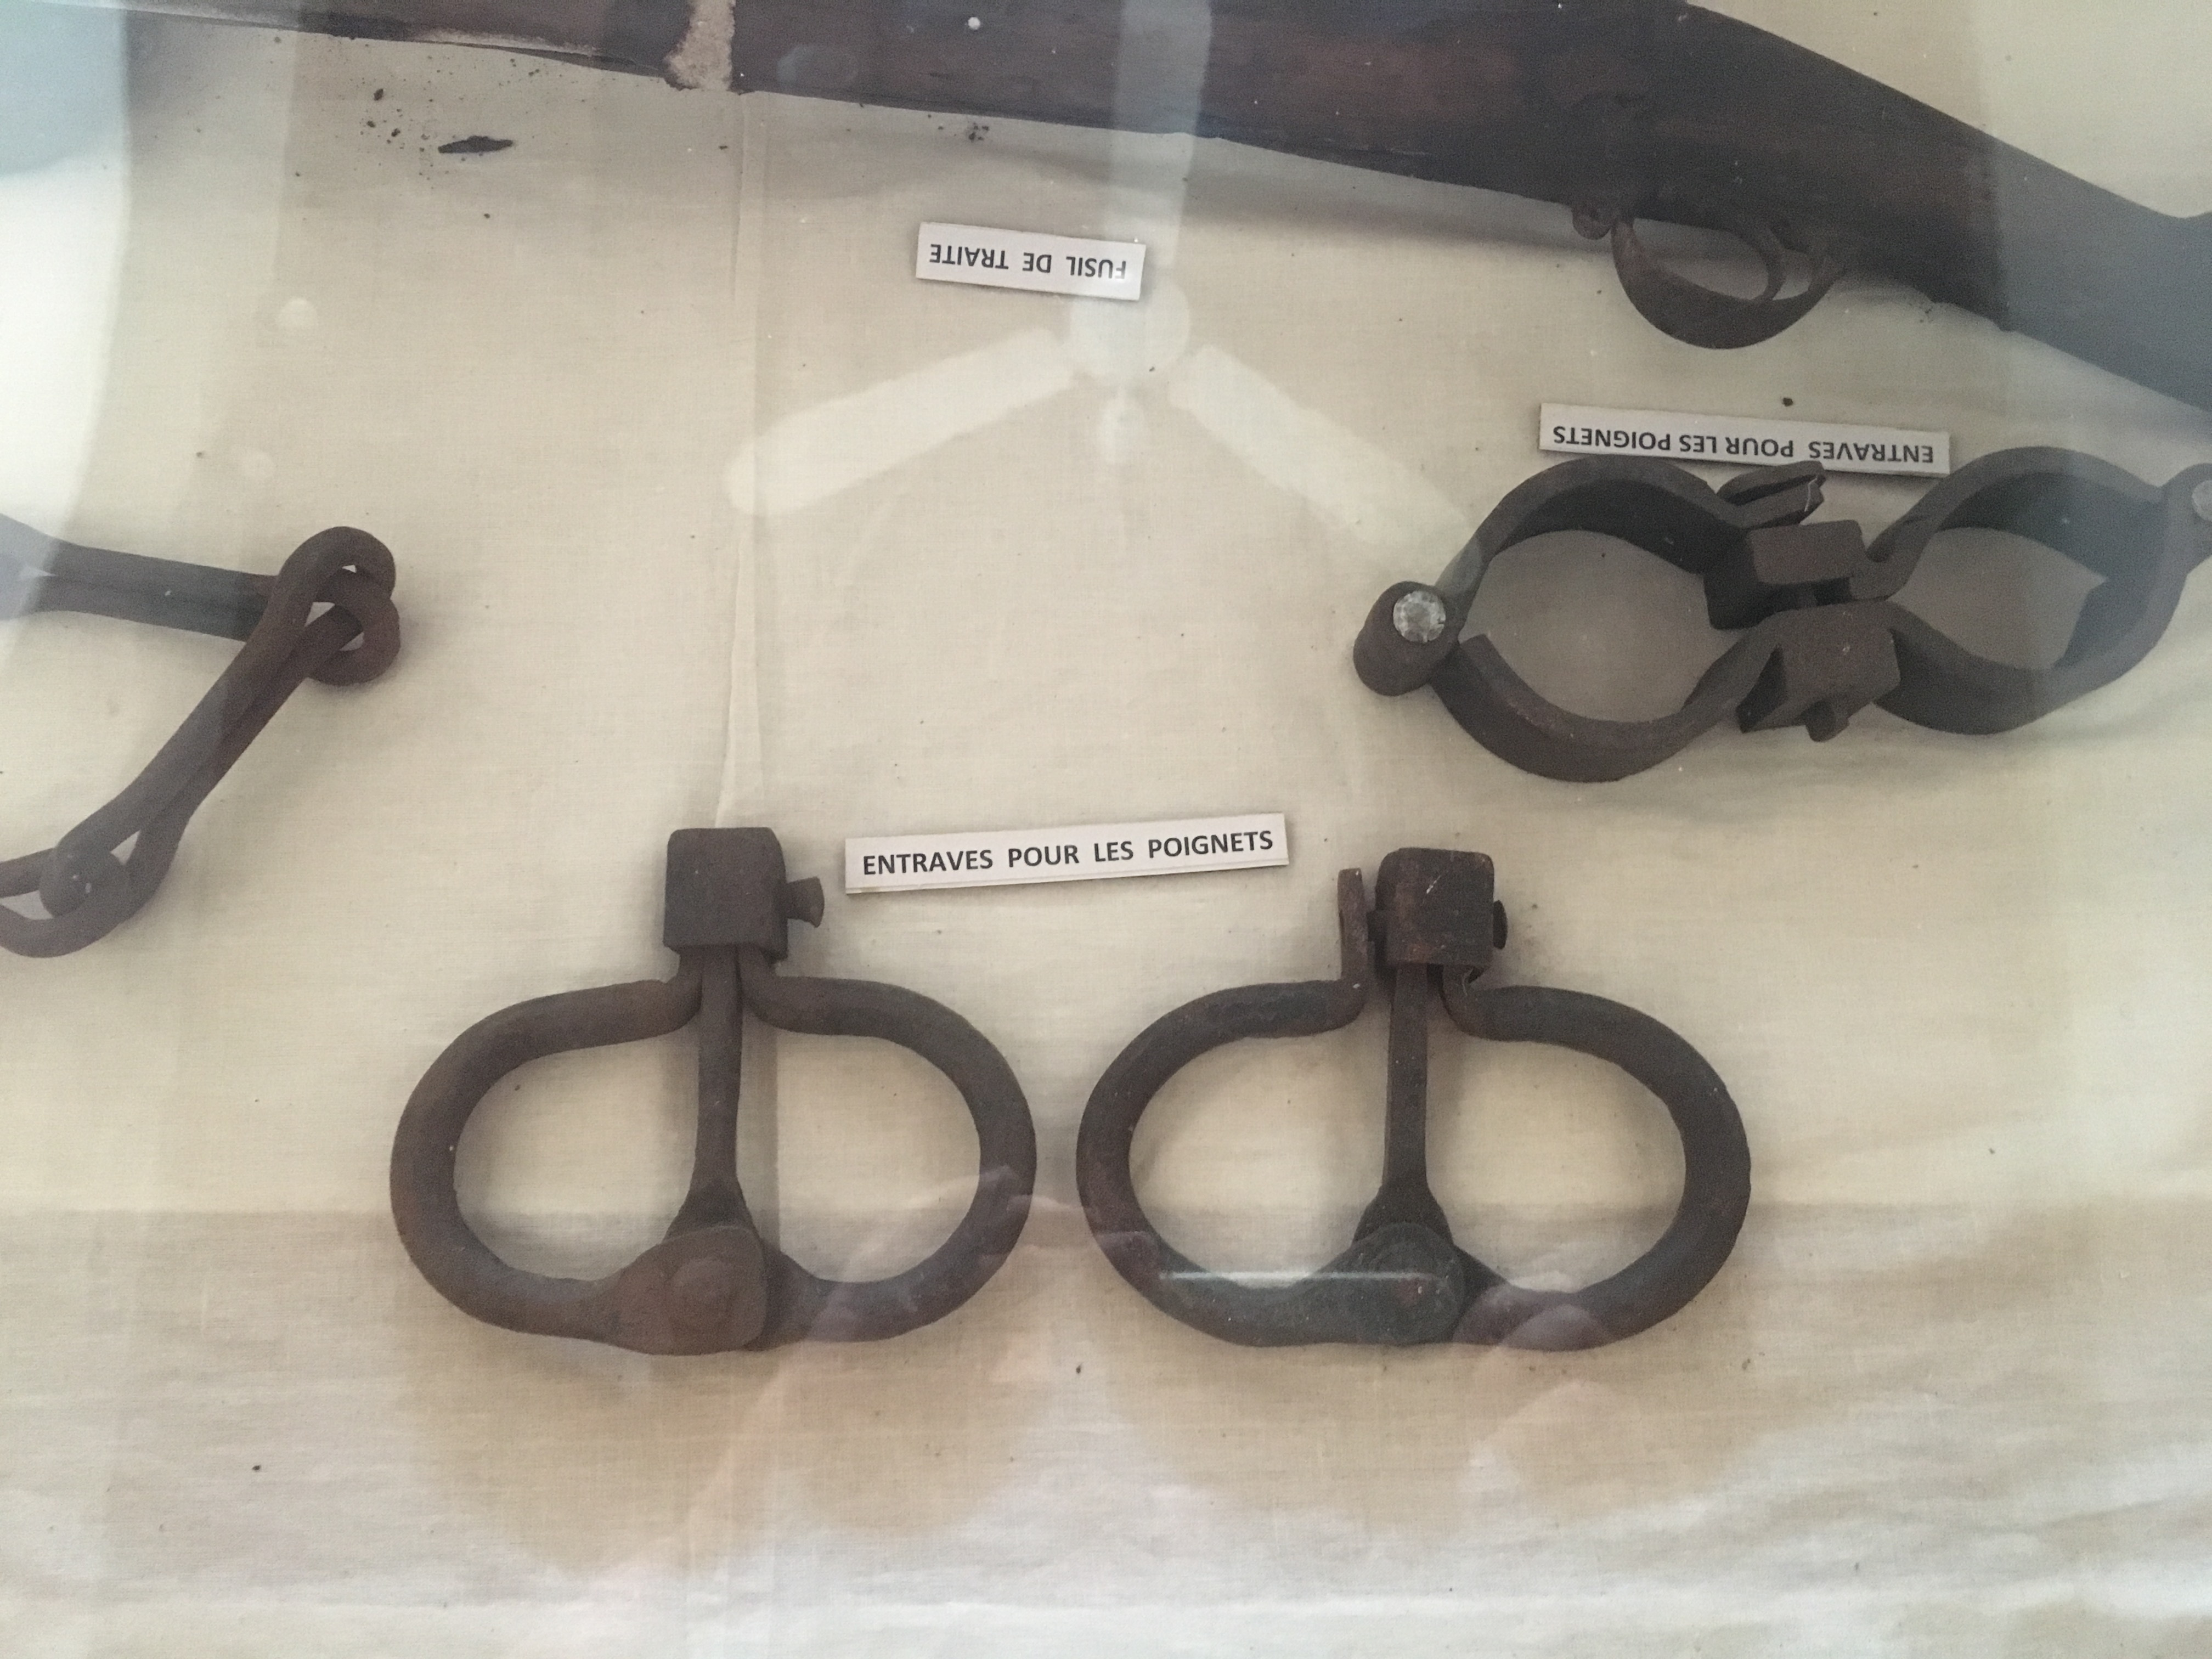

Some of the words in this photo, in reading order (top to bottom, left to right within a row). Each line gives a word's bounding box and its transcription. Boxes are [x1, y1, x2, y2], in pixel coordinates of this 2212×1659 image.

[929, 244, 1008, 269] TRAITE
[1023, 252, 1052, 273] DE
[1066, 256, 1126, 279] FUSIL
[1553, 426, 1671, 451] POIGNETS
[1680, 433, 1717, 453] LES
[1726, 436, 1793, 458] POUR
[1809, 441, 1933, 462] ENTRAVES
[863, 849, 992, 875] ENTRAVES
[1008, 844, 1080, 868] POUR
[1094, 841, 1133, 863] LES
[1148, 830, 1273, 859] POIGNETS
